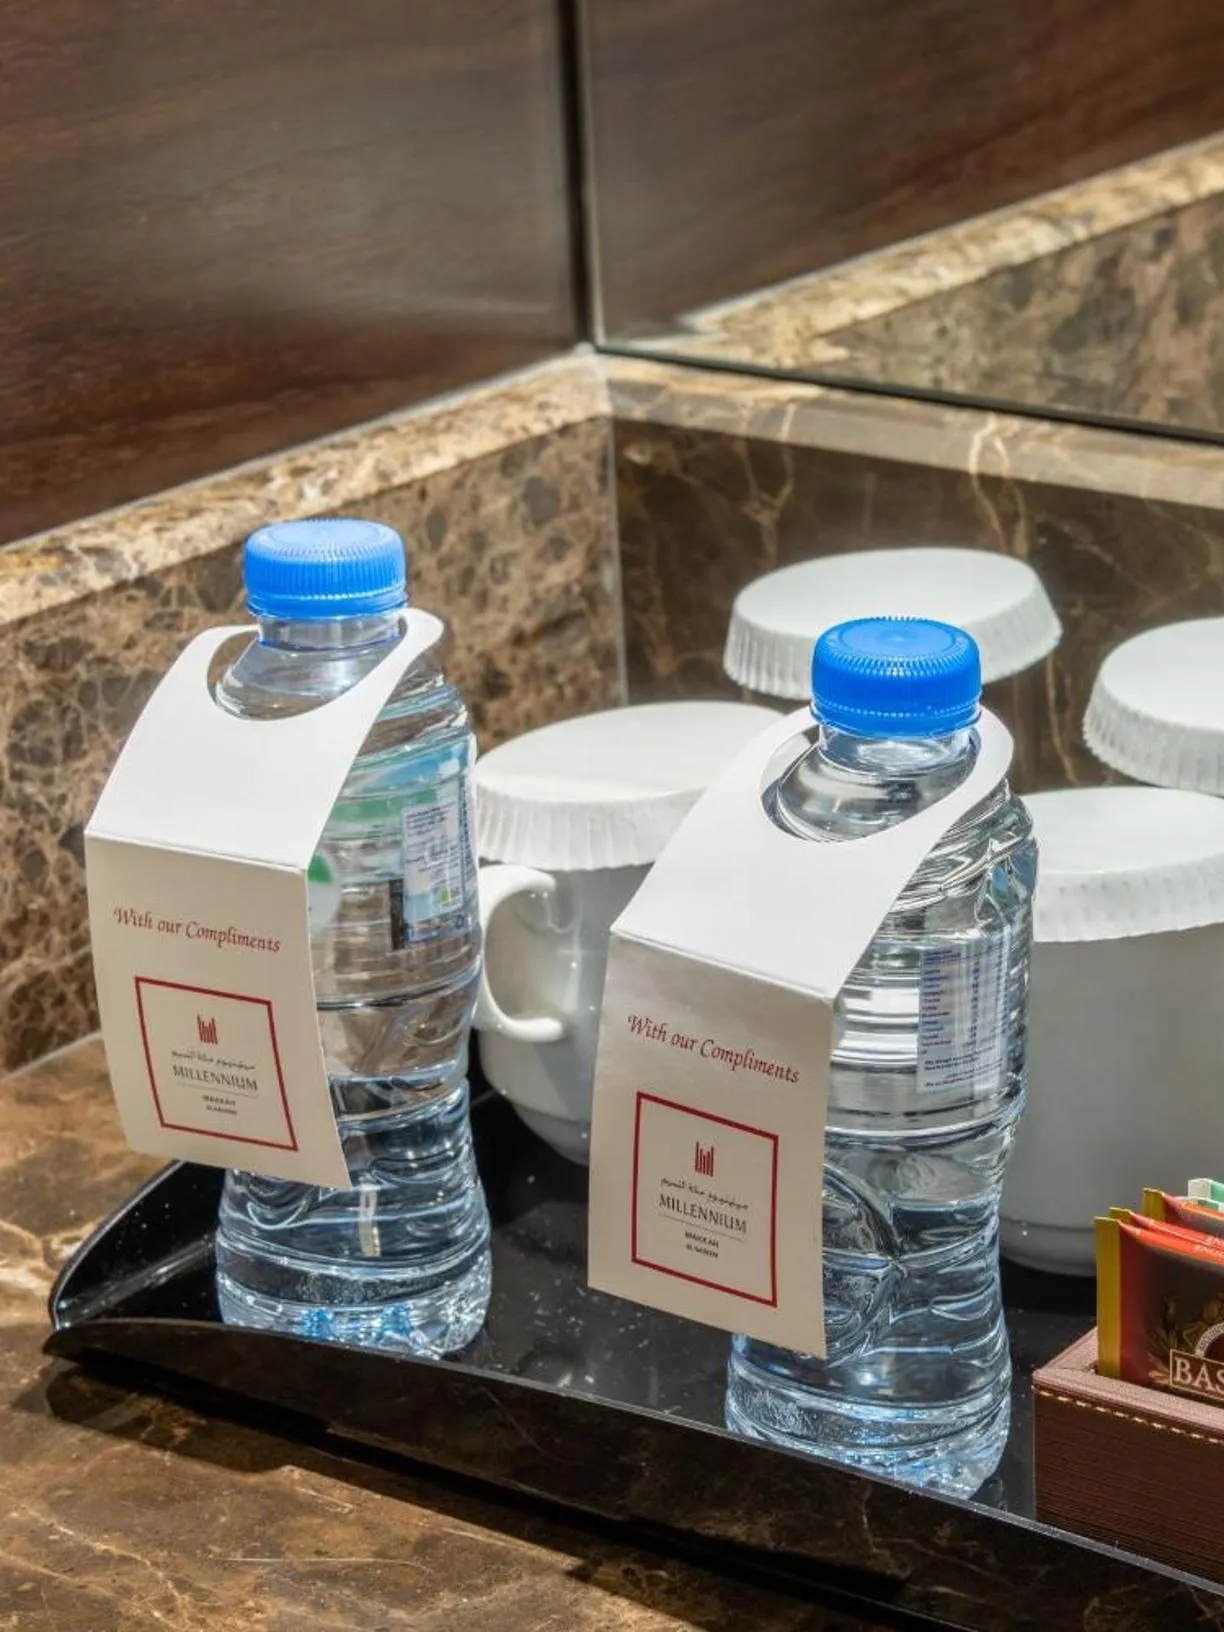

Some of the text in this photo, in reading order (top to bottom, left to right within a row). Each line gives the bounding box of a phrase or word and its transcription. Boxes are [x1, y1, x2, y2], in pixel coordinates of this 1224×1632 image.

[113, 906, 282, 953] With our Compliments
[627, 1013, 801, 1085] With our Compliments
[172, 1064, 258, 1091] MILLENNIUM
[659, 1193, 747, 1234] MILLENNIUM
